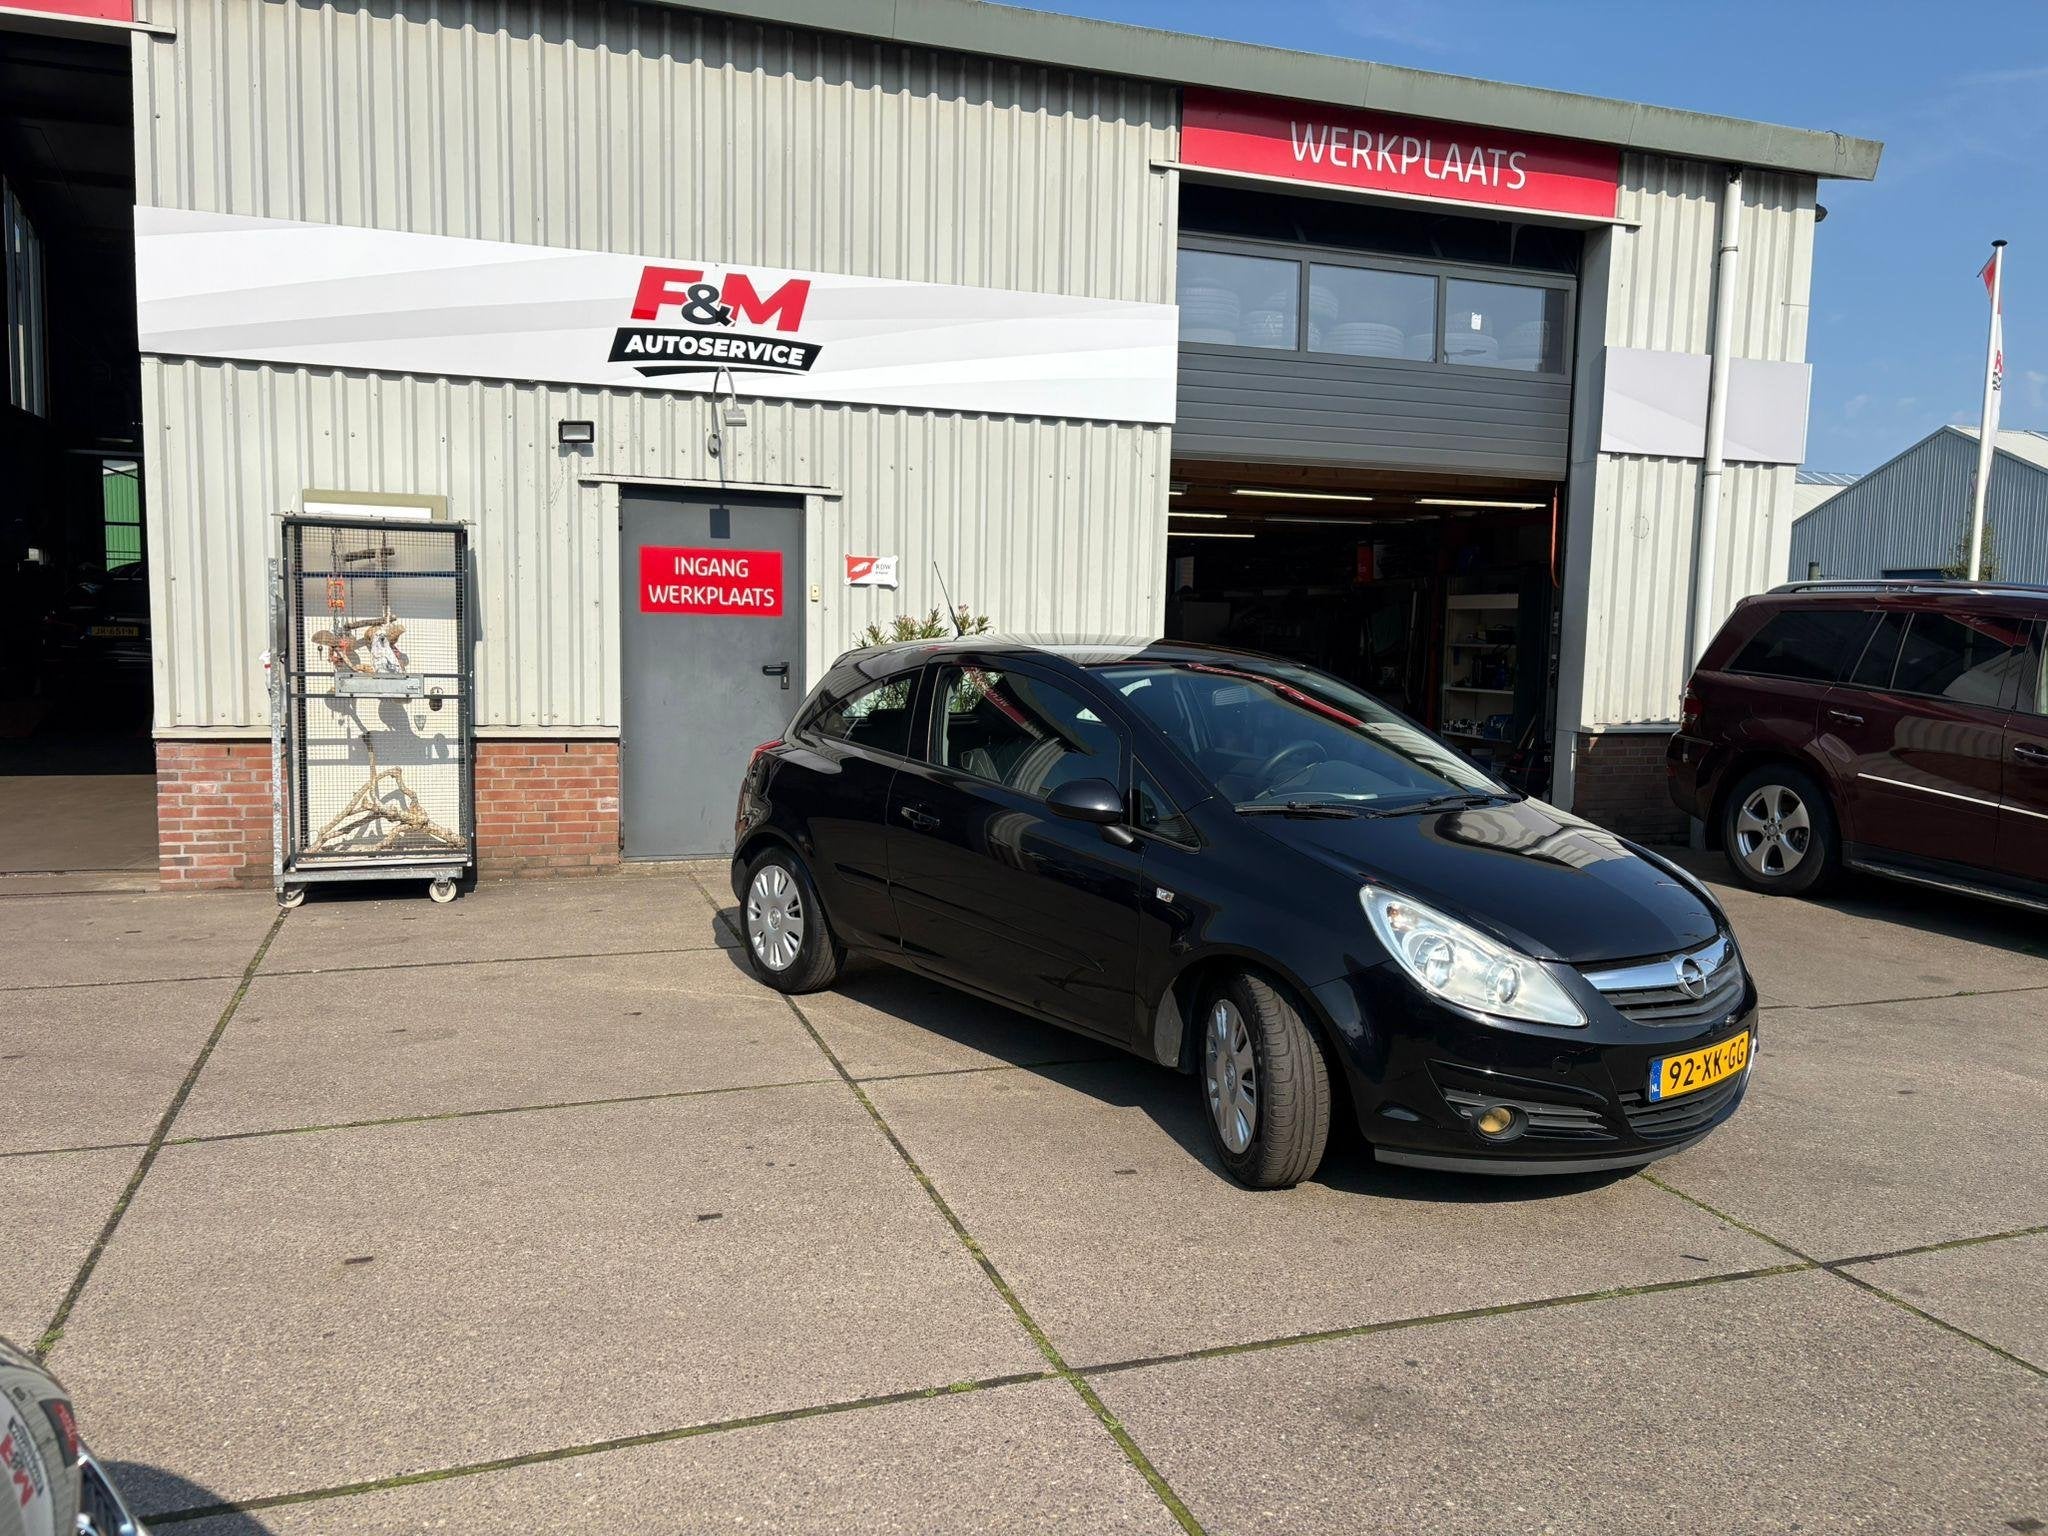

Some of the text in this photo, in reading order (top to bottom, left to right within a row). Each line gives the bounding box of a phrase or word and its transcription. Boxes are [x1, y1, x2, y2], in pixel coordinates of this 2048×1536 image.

[1290, 120, 1527, 190] WERKPLAATS
[630, 265, 811, 332] F&M
[624, 334, 806, 366] AUTOSERVICE
[674, 556, 749, 577] INGANG
[648, 584, 775, 607] WERKPLAATS
[1651, 1038, 1745, 1093] NL 92-XK-GG
